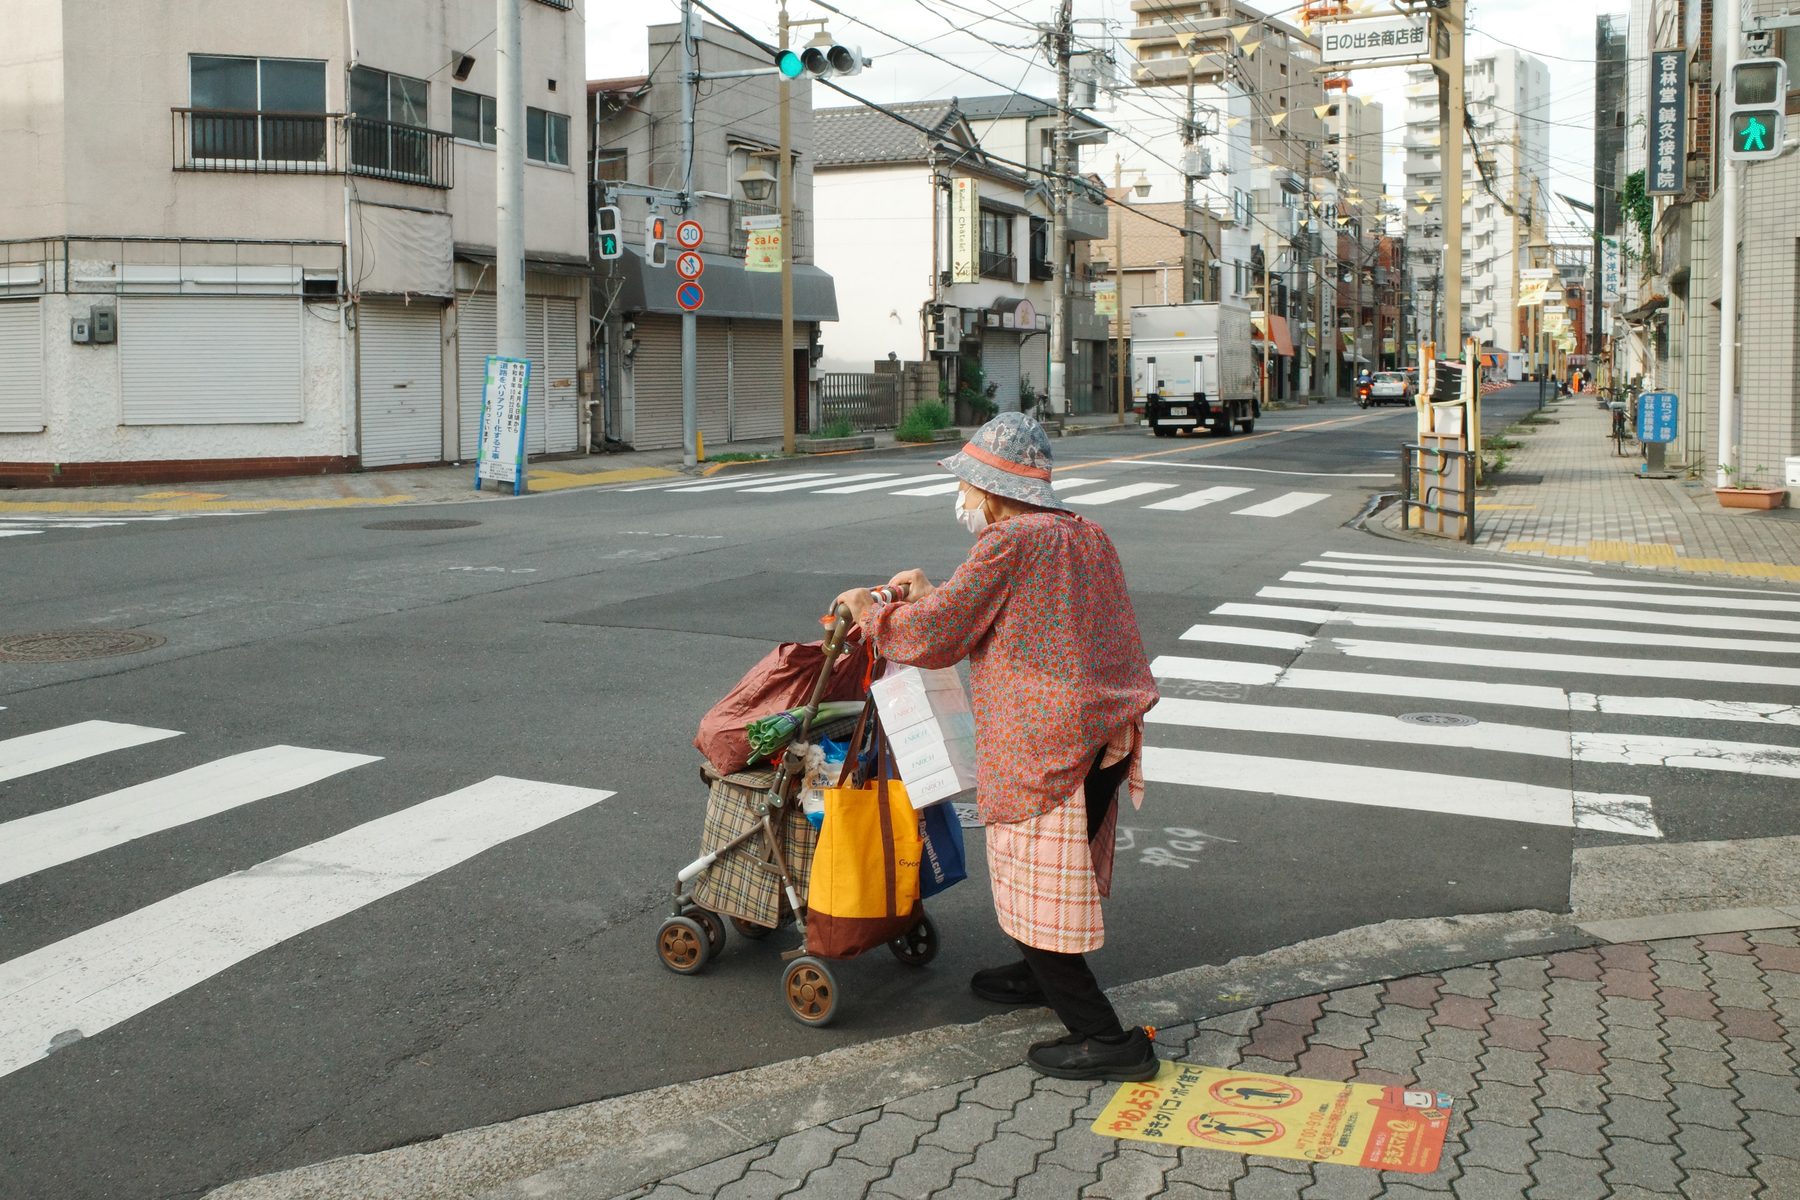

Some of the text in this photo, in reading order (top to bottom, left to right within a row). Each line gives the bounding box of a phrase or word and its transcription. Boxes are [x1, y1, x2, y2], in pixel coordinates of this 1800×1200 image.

[1326, 27, 1424, 51] 日の出会商店街
[683, 228, 698, 241] 30
[754, 235, 779, 246] sale
[912, 753, 935, 769] ENRICH
[921, 778, 945, 794] ENRICH
[1107, 1082, 1165, 1132] やめよう!
[1142, 1067, 1203, 1137] 歩きタバコ・ポイ捨て
